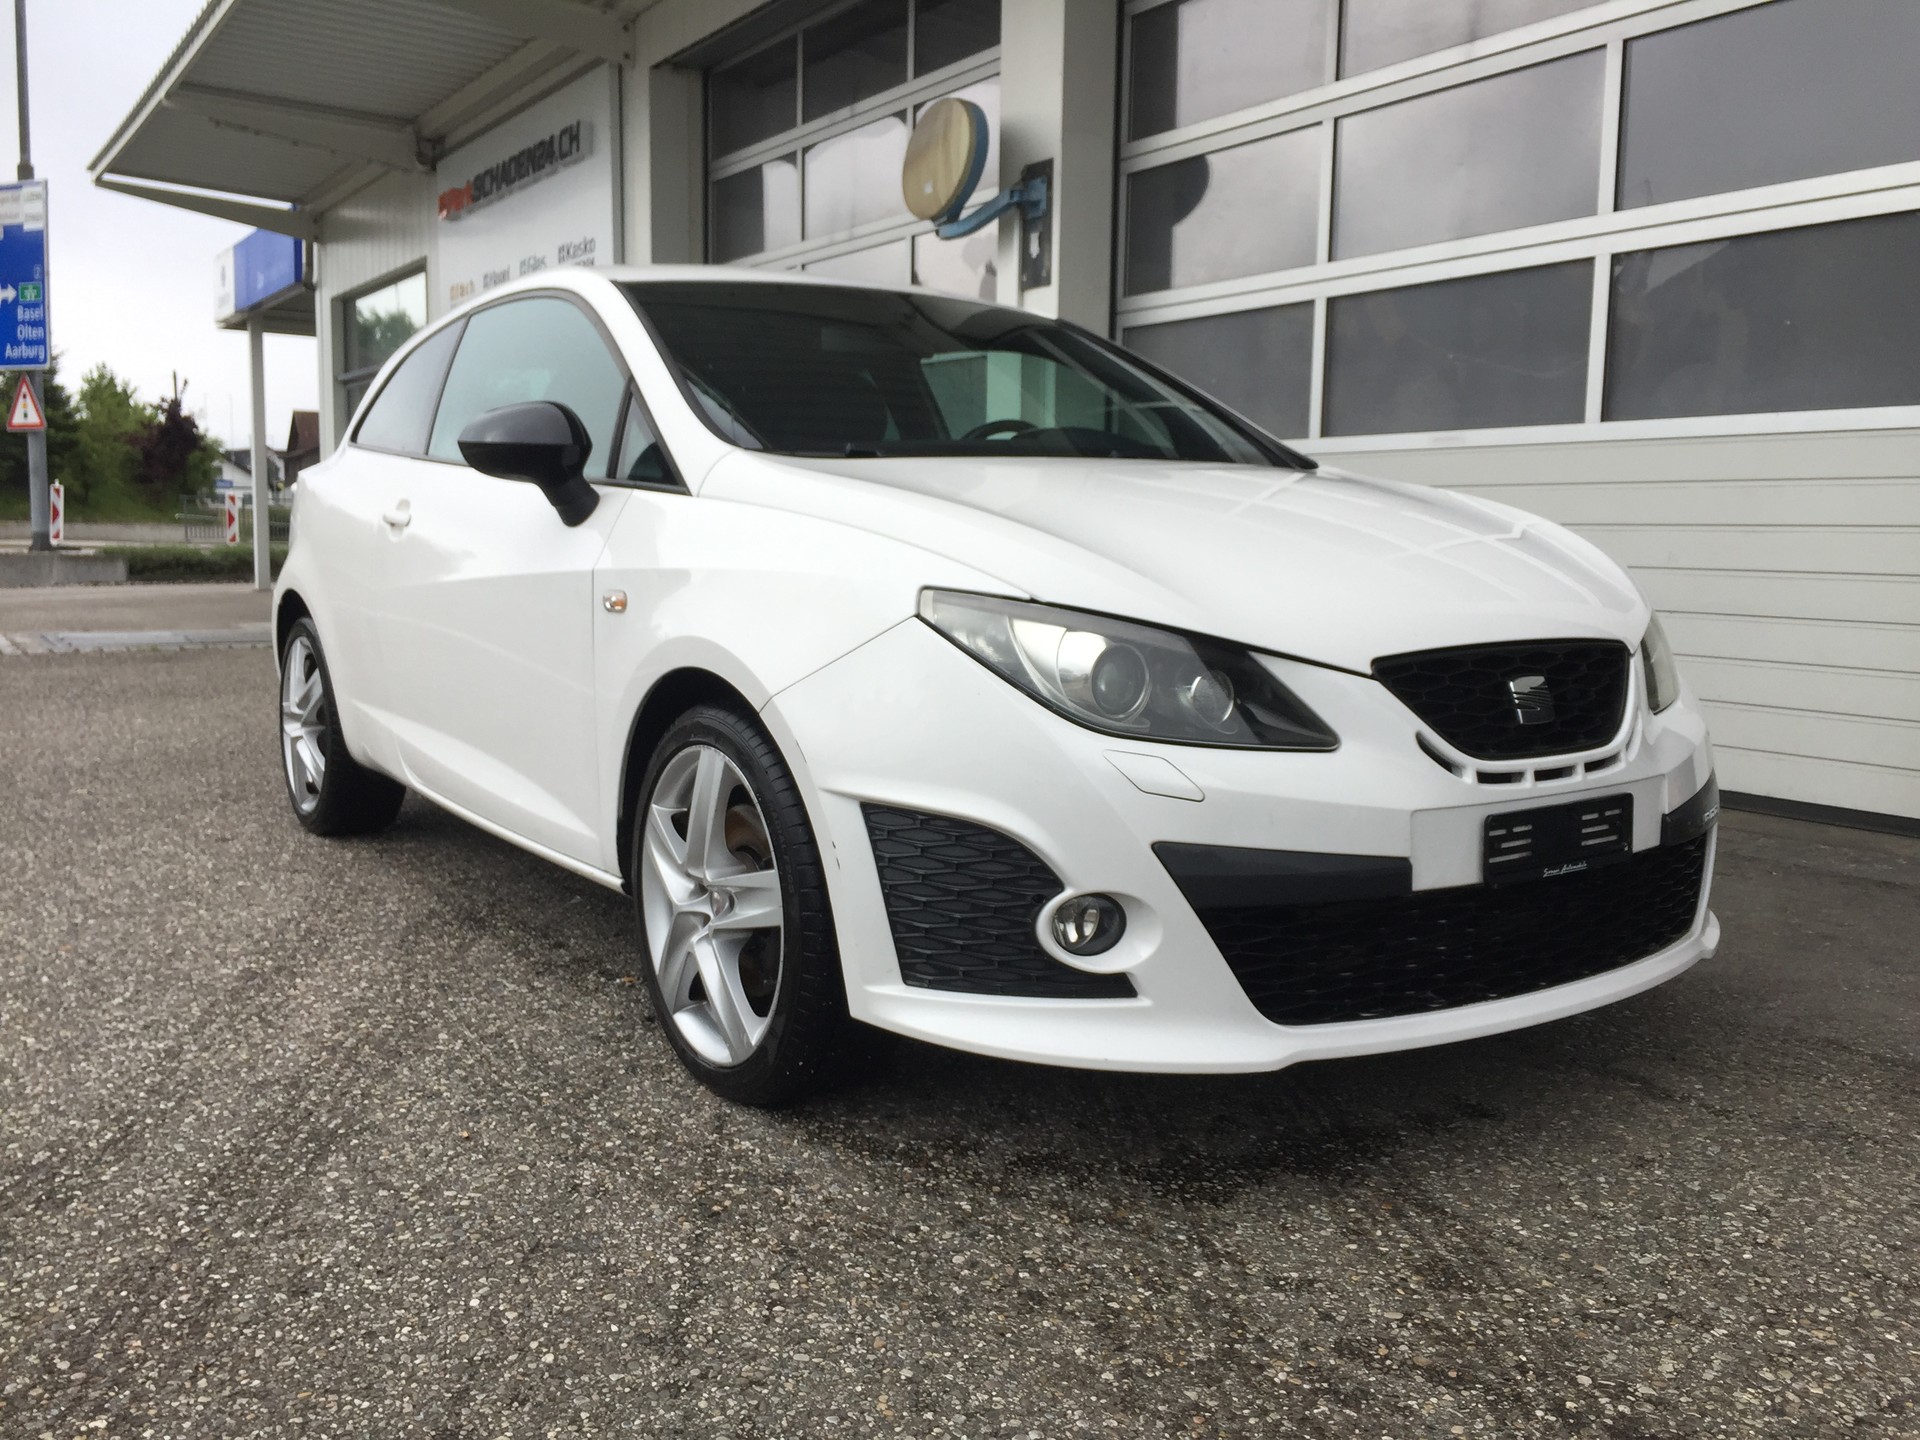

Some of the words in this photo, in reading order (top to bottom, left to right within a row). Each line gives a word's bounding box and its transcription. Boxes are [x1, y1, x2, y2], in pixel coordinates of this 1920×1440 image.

[17, 304, 43, 321] Basel
[17, 323, 44, 340] Olten
[5, 342, 45, 362] Aarburg
